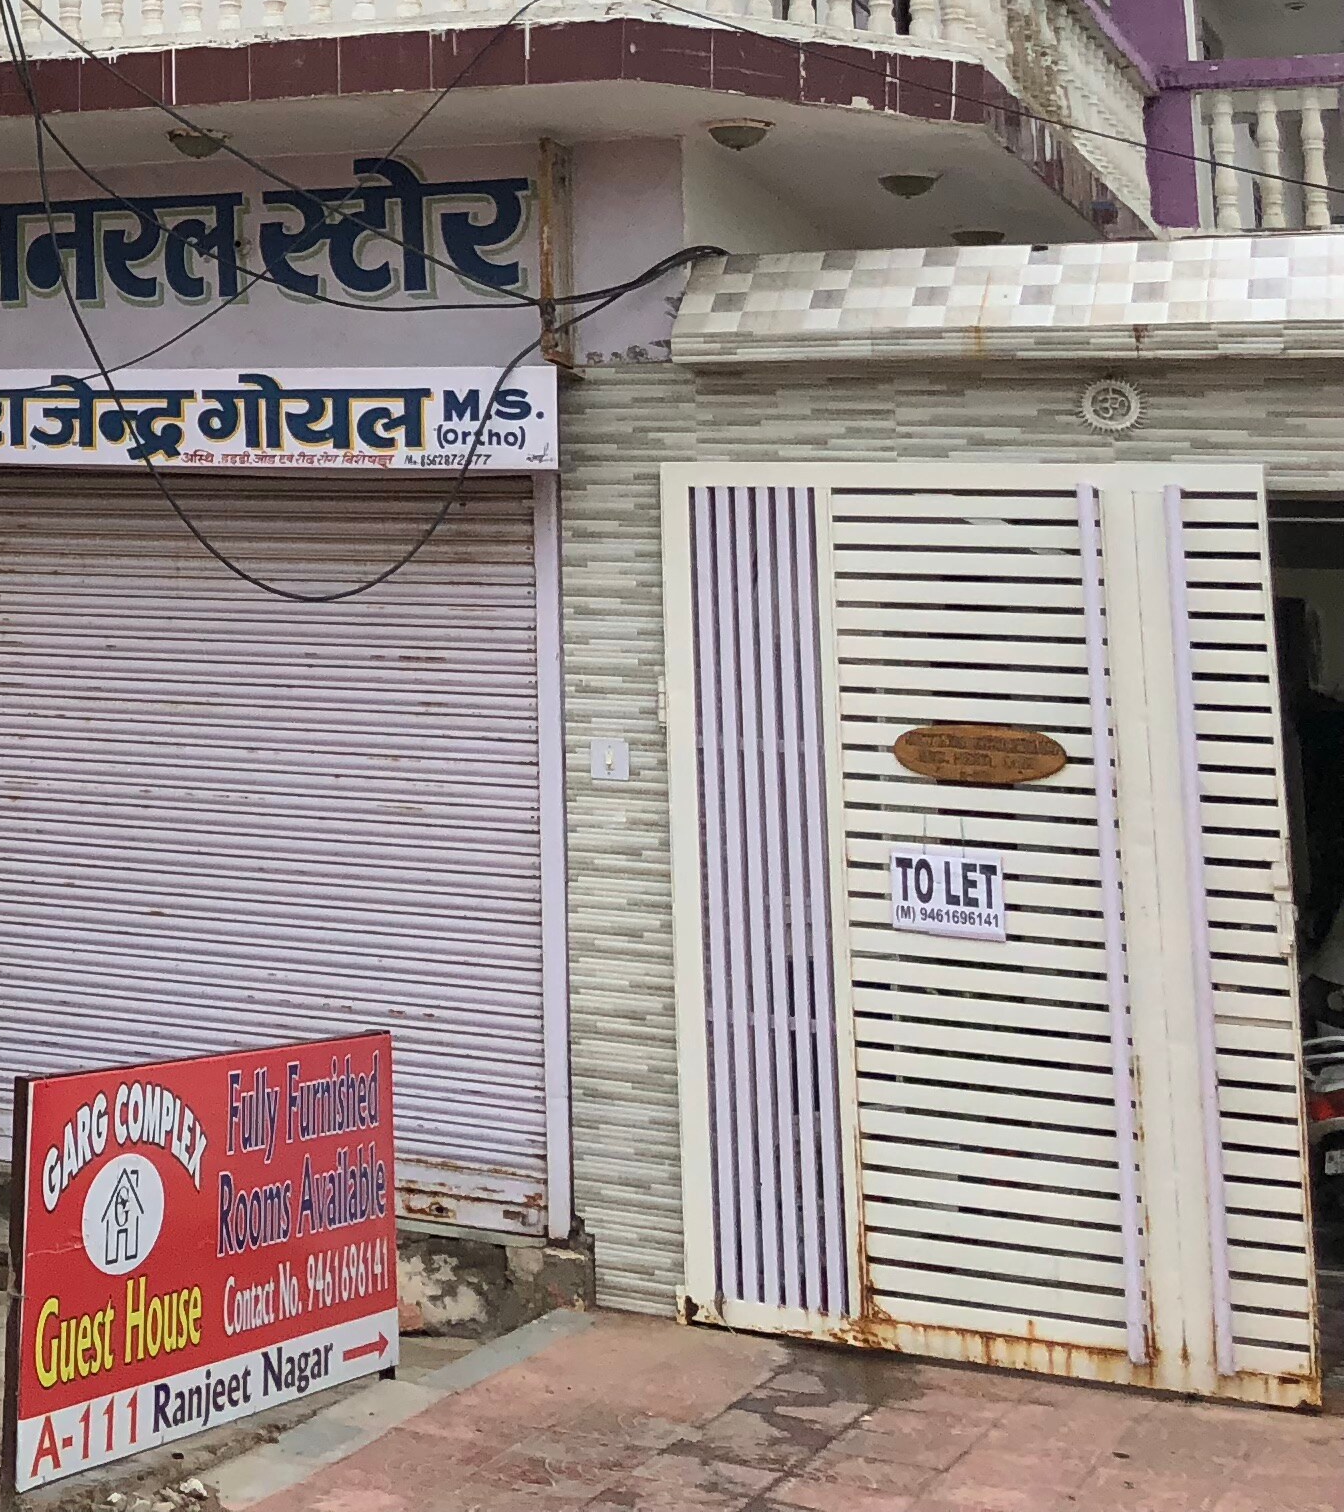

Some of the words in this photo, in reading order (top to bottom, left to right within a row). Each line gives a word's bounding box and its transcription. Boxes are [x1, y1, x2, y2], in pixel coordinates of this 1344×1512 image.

[259, 156, 530, 294] स्टोर
[198, 373, 432, 451] गोयल
[420, 453, 492, 467] 856287277
[895, 856, 935, 905] TO
[943, 860, 998, 910] LET
[895, 904, 917, 924] (M)
[919, 907, 999, 929] 9461696141
[42, 1092, 110, 1213] GARG
[113, 1081, 209, 1192] COMPLEX
[226, 1065, 281, 1164] Fully
[285, 1049, 380, 1144] Furnished
[216, 1169, 293, 1258] Rooms
[295, 1140, 387, 1238] Available
[34, 1295, 115, 1389] Guest
[123, 1273, 204, 1365] House
[223, 1264, 276, 1337] Contact
[278, 1261, 304, 1324] No.
[306, 1236, 390, 1313] 9461696141
[151, 1364, 253, 1435] Ranjeet
[261, 1341, 335, 1400] Nagar
